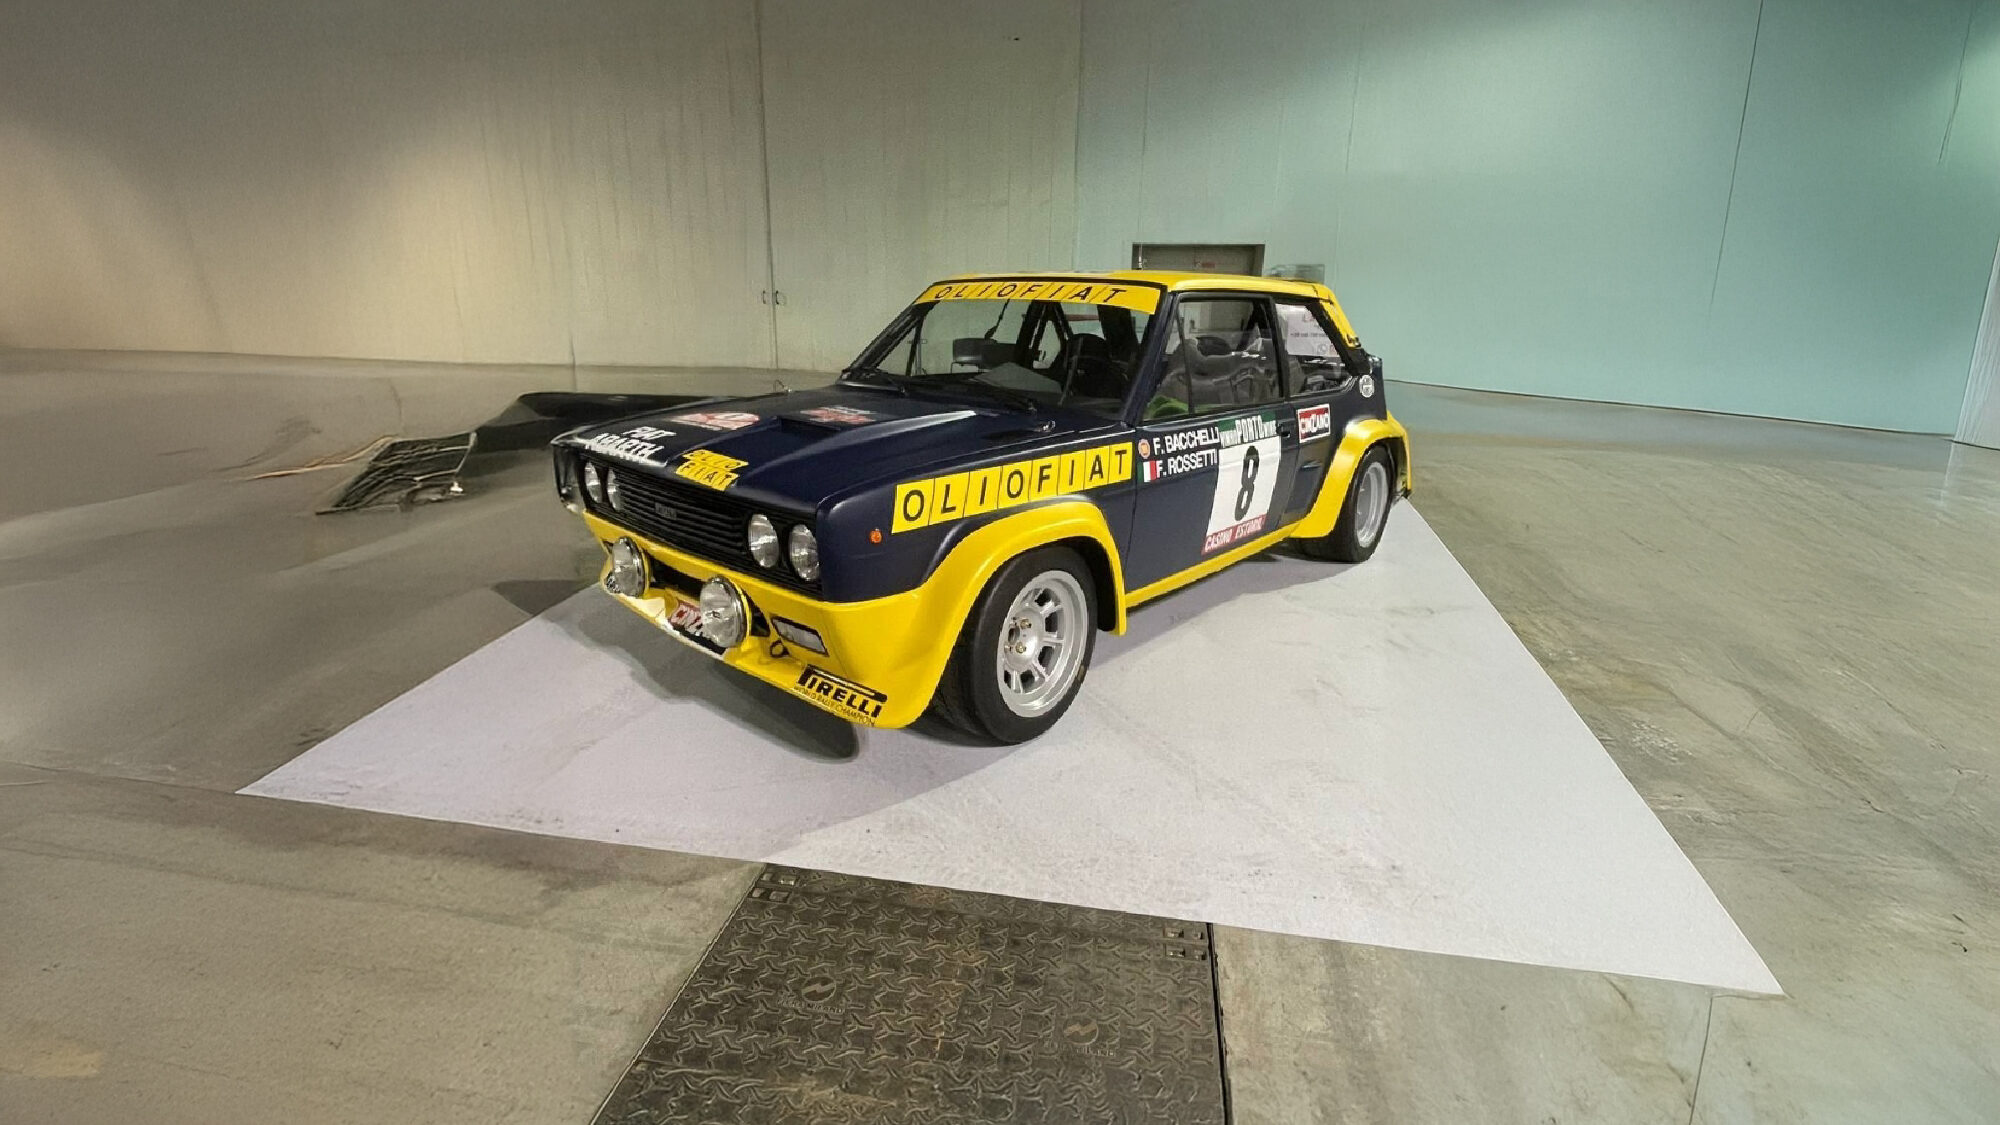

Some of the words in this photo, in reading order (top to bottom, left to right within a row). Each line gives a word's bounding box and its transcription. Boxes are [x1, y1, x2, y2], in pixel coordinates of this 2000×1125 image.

[934, 283, 1127, 303] OLIOFIAT
[1153, 437, 1166, 456] F.
[1165, 426, 1220, 454] BACCHELLI
[1235, 414, 1264, 443] PORTO
[1155, 459, 1167, 478] F.
[1167, 448, 1218, 475] ROSSETTI
[902, 449, 1128, 522] OLIOFIAT
[1234, 445, 1260, 521] 8
[797, 663, 888, 719] PIRELLI
